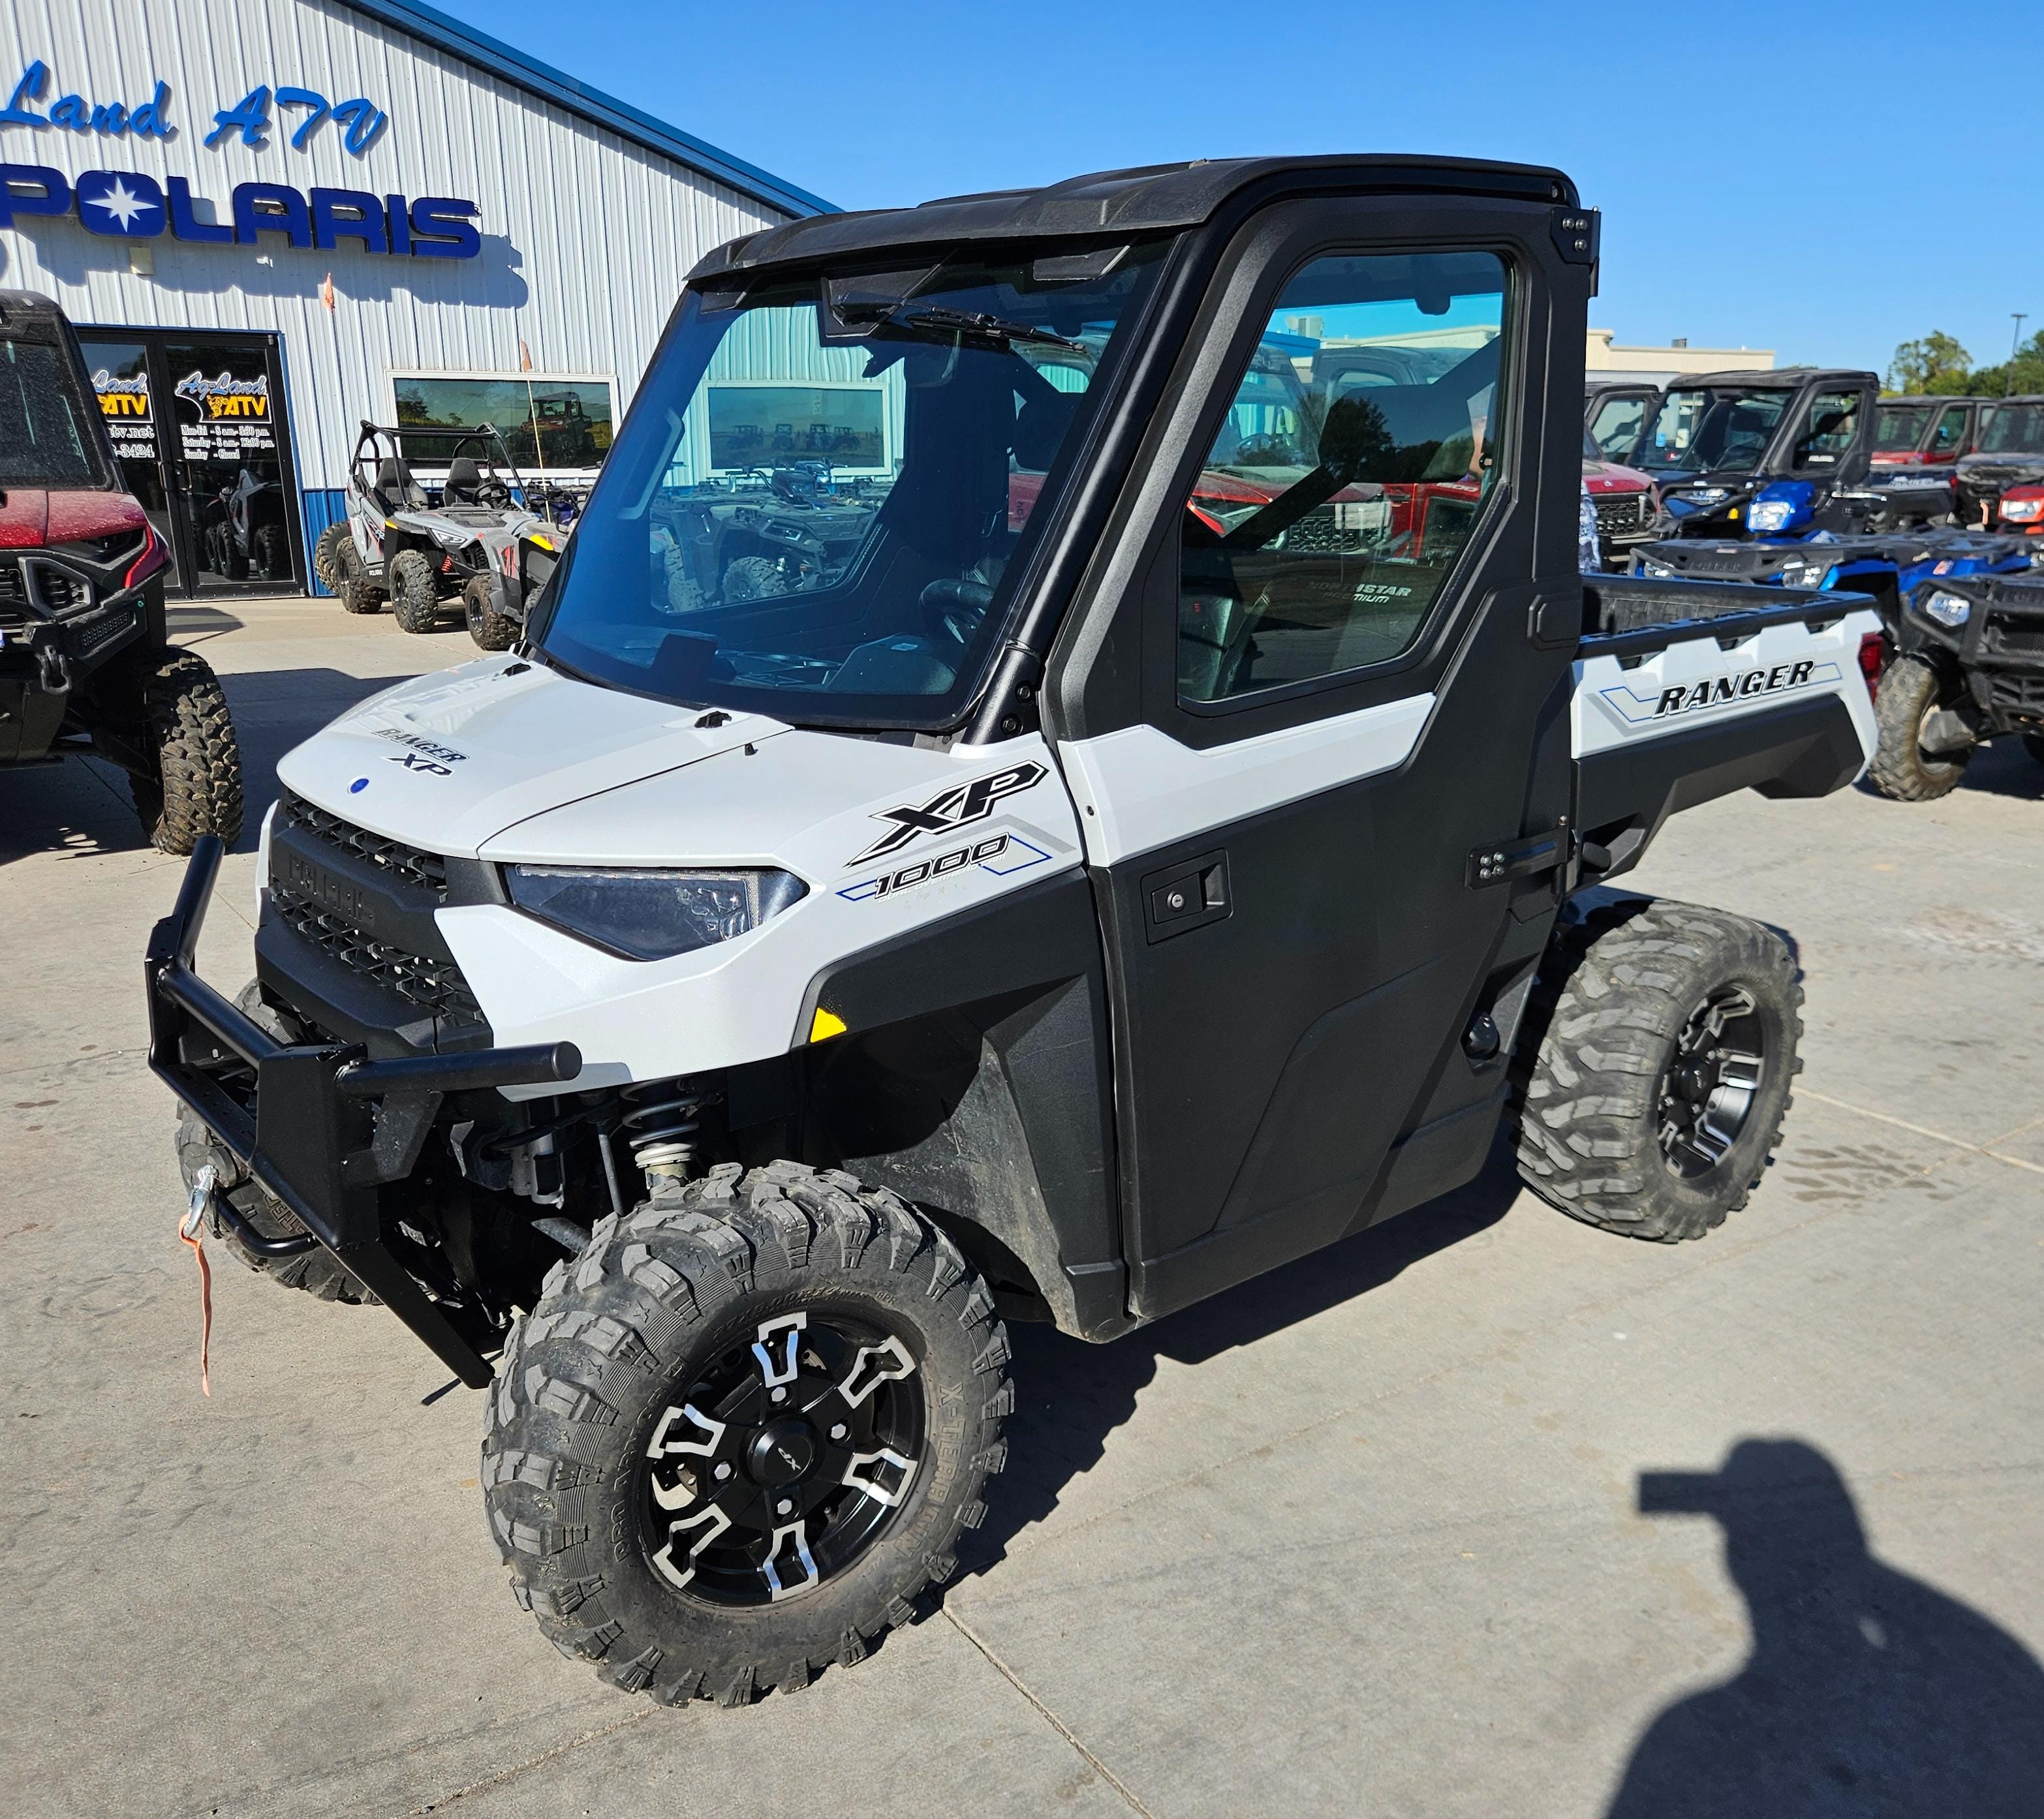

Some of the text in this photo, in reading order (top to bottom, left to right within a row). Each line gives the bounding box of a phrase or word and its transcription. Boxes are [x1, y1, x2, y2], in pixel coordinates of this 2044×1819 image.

[204, 85, 388, 156] ATV
[0, 163, 482, 259] POLARIS
[176, 371, 267, 401] Ag-Land
[102, 394, 147, 416] ATV
[223, 395, 266, 416] ATV
[180, 425, 208, 436] Mon-Fri
[182, 436, 211, 448] Saturday
[184, 448, 208, 461] Sunday
[218, 448, 241, 459] Closed
[1323, 592, 1390, 604] PREMIUM
[1652, 660, 1815, 719] RANGER
[371, 728, 469, 764] RANGER
[381, 751, 455, 776] XP
[842, 759, 1050, 868] XP
[874, 831, 1010, 899] 1000
[778, 1447, 801, 1471] XP
[893, 1381, 967, 1557] X-TERRAIN
